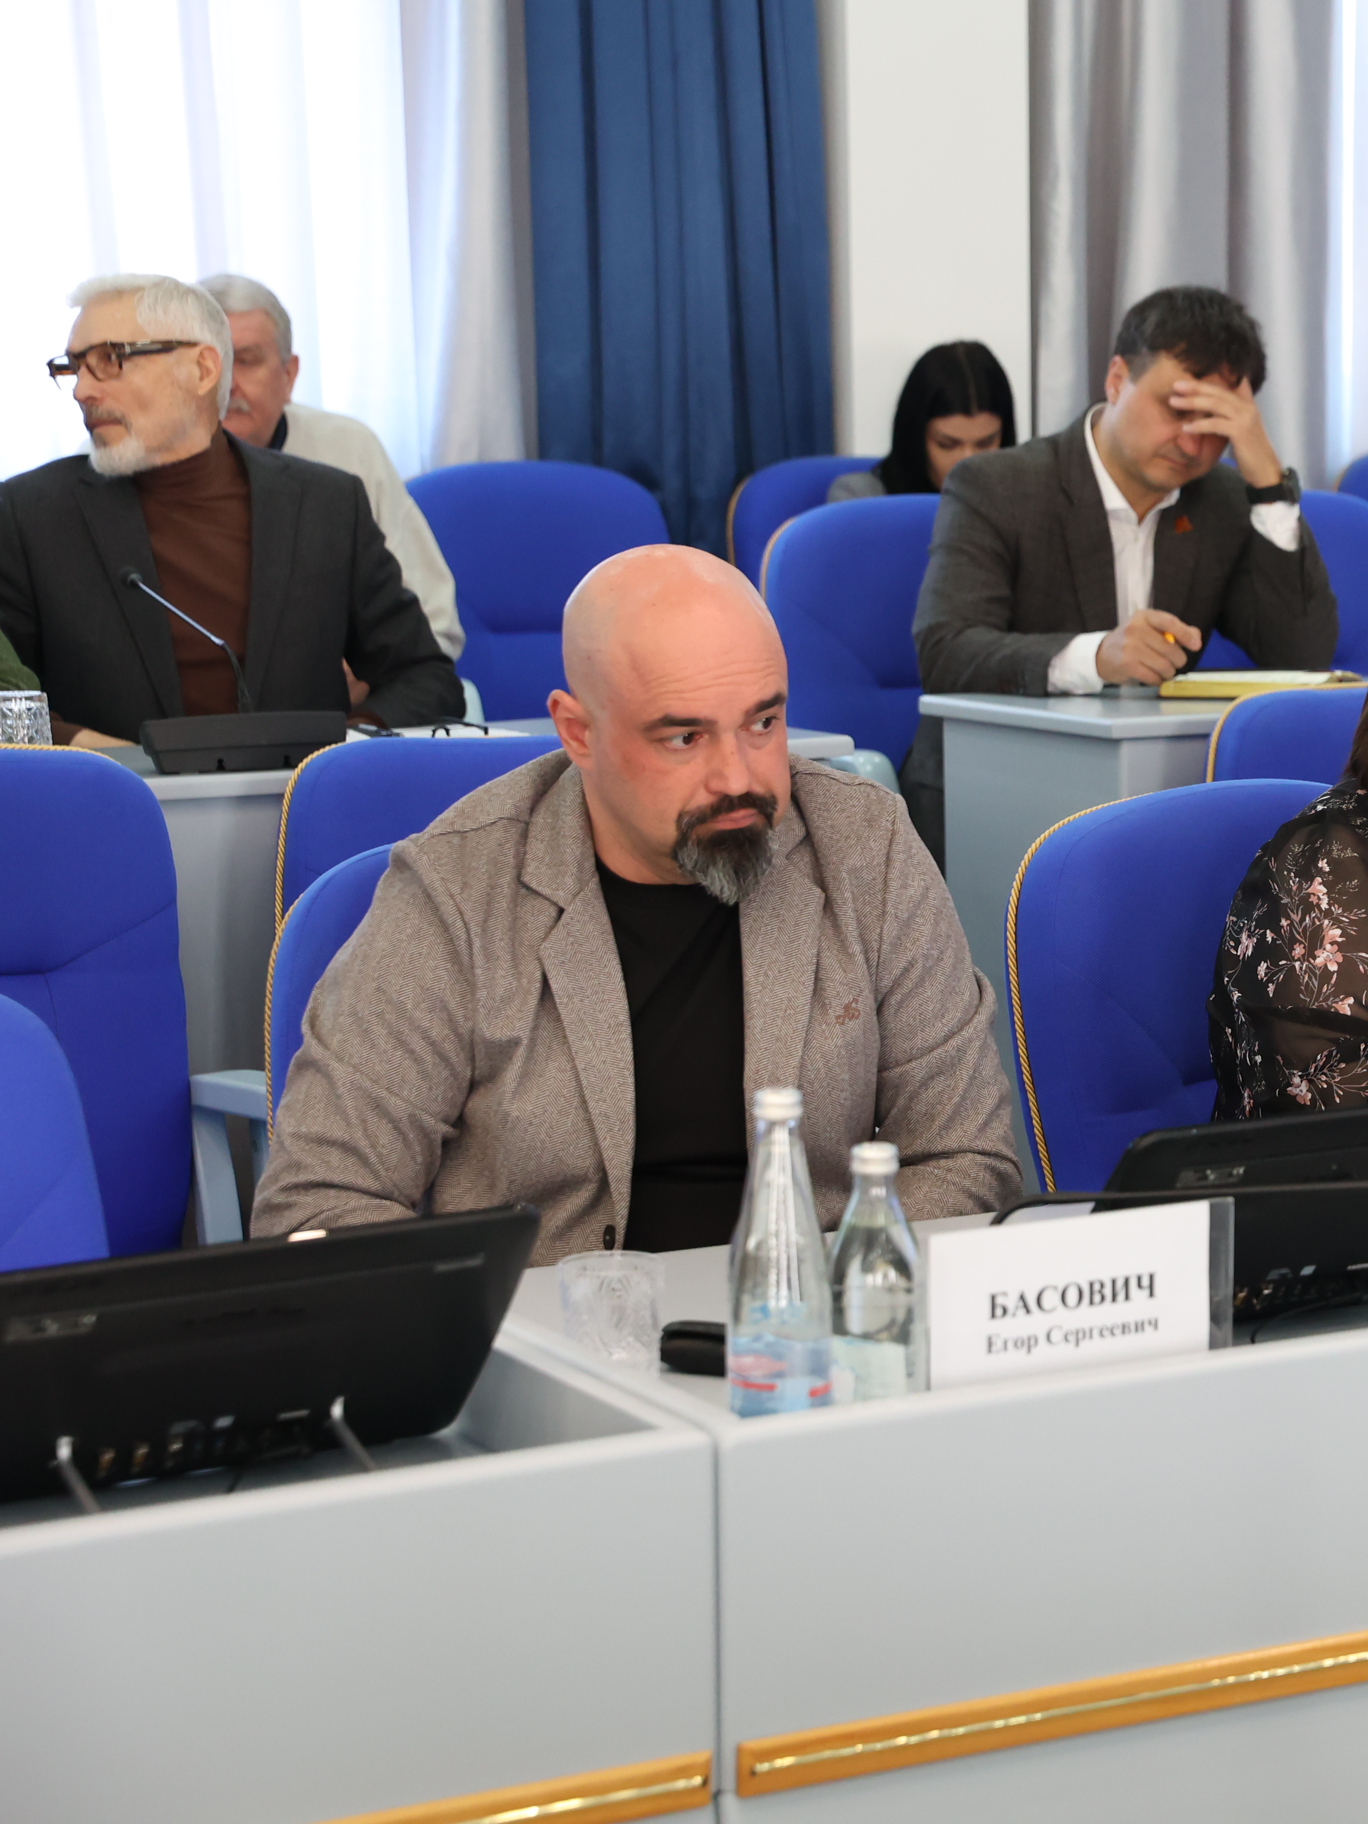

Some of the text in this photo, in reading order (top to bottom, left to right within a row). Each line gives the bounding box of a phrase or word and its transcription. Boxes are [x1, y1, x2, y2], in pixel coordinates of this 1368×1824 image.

[988, 1271, 1156, 1320] БАСОВИЧ
[986, 1316, 1159, 1355] Егор Сергеевич
